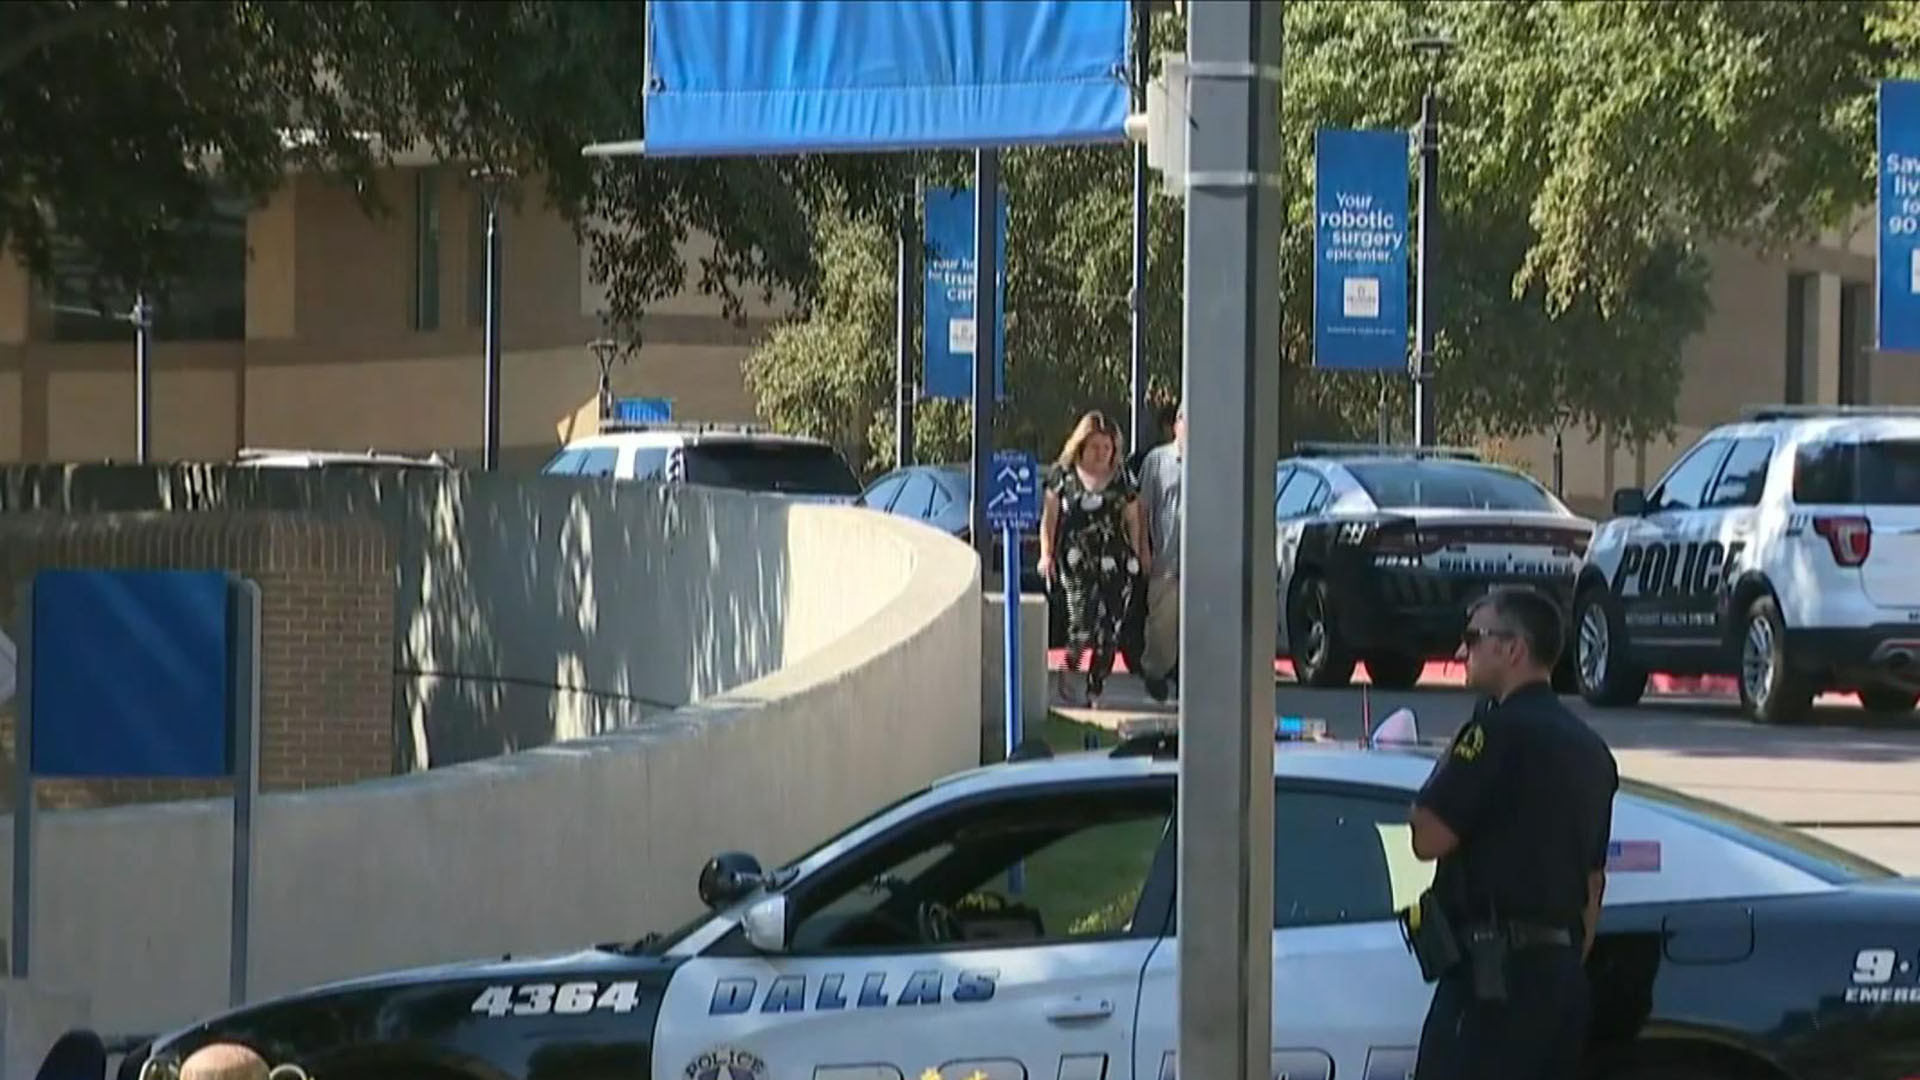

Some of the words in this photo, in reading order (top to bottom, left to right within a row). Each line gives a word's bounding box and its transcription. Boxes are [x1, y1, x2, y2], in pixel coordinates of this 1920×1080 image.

[1336, 191, 1373, 211] Your
[1320, 207, 1395, 229] robotic
[1332, 230, 1403, 251] surgery
[1325, 247, 1394, 264] epicenter.
[946, 288, 975, 302] car
[1611, 540, 1747, 597] POLICE
[471, 980, 640, 1018] 4364
[708, 968, 1001, 1016] DALLAS
[685, 1049, 765, 1080] POLICE
